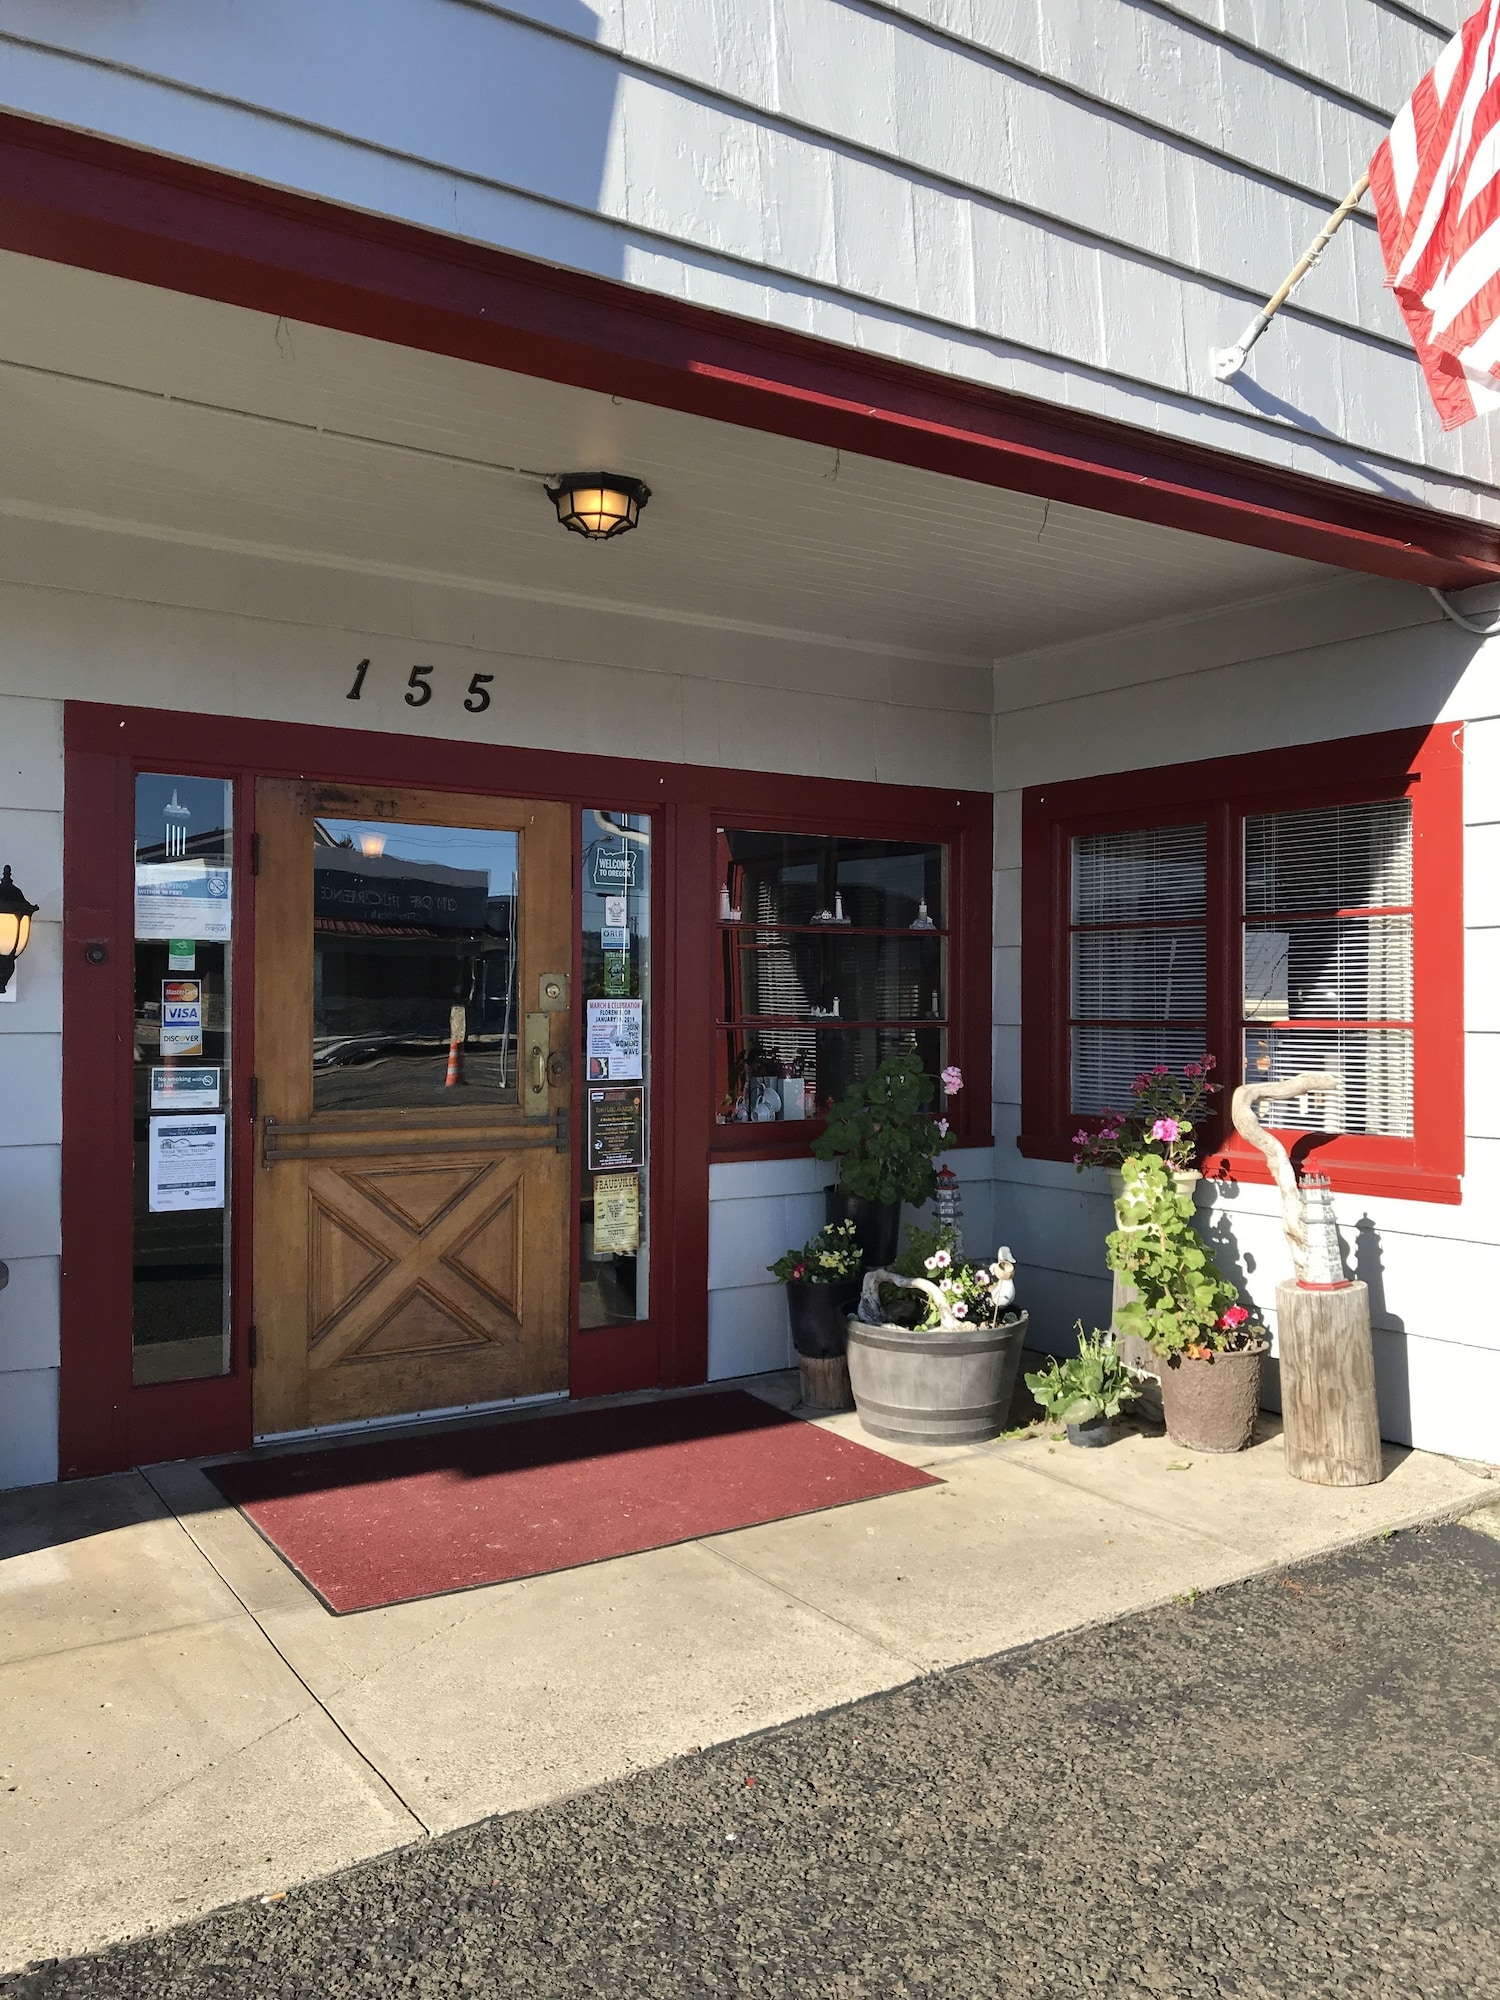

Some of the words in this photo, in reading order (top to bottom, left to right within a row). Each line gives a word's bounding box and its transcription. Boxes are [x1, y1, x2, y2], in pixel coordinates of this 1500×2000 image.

[346, 658, 494, 713] 155
[599, 858, 631, 870] WELCOME
[169, 1008, 198, 1018] VISA
[595, 1177, 637, 1191] FRAUDVILLE
